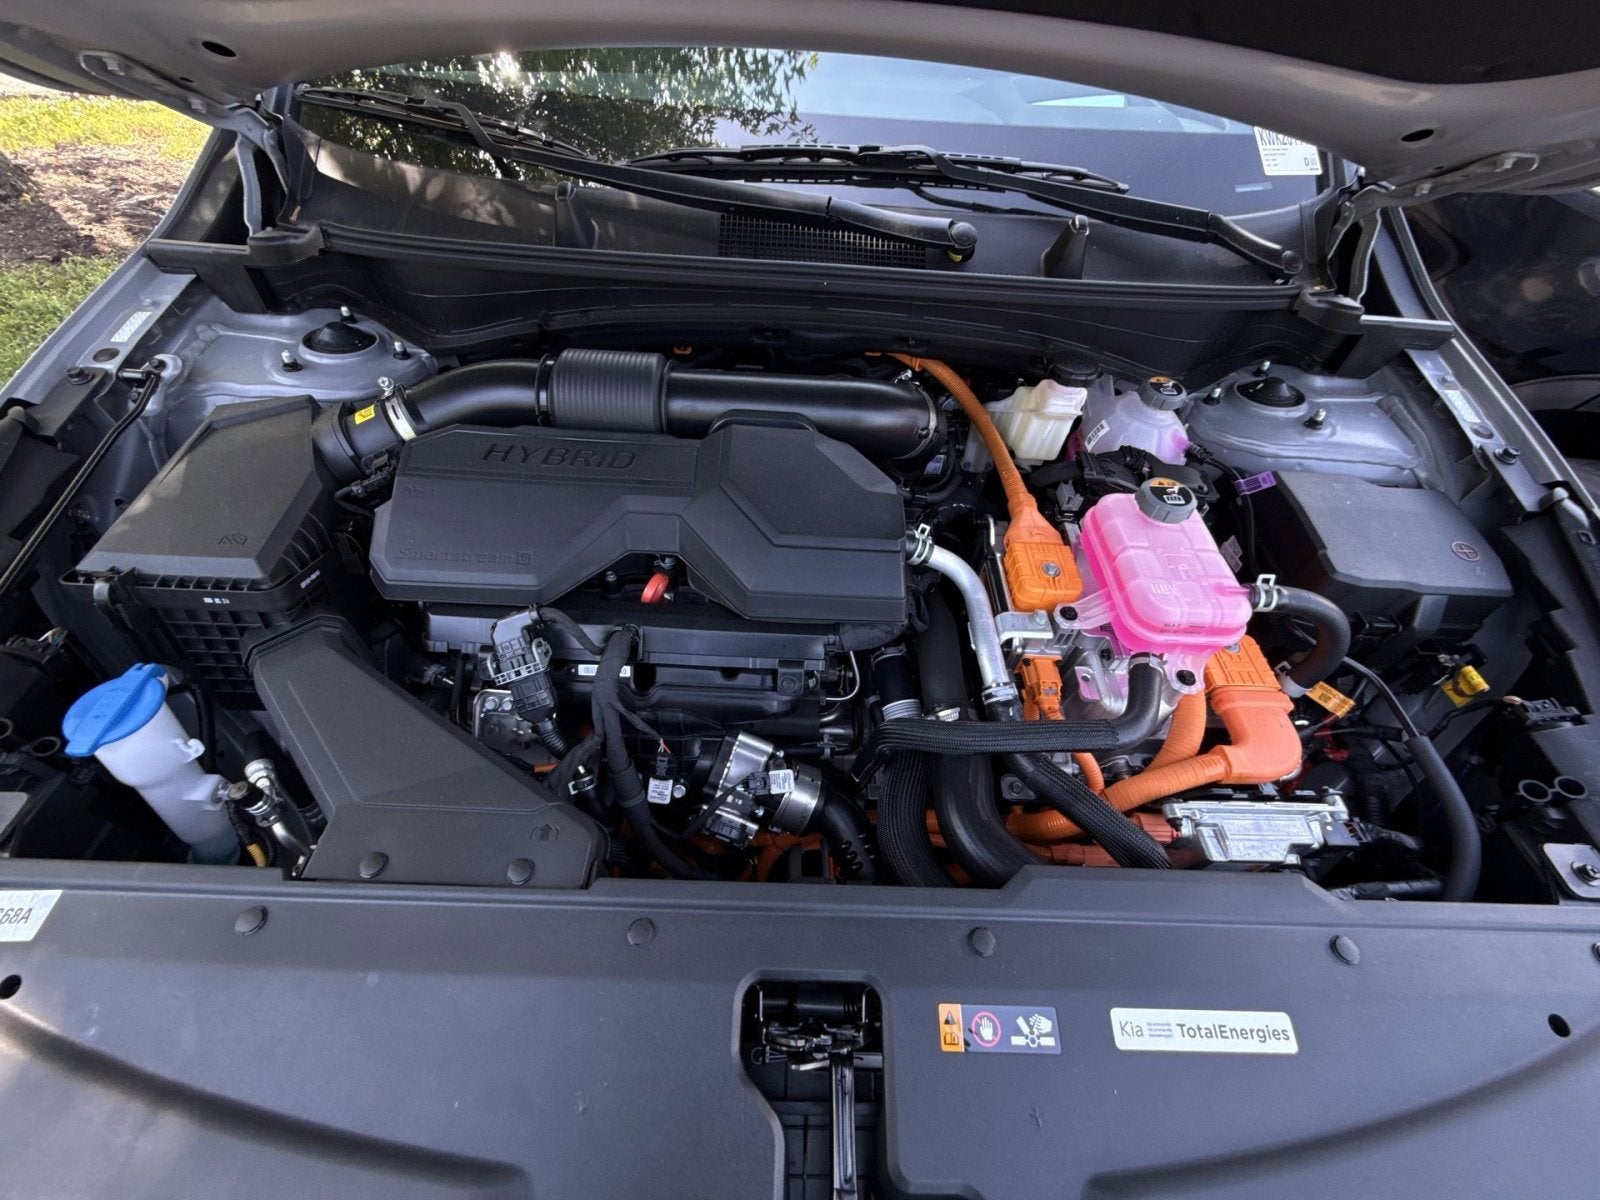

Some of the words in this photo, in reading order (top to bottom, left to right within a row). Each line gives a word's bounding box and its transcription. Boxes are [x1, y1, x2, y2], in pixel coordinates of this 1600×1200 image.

[482, 443, 637, 471] HYBRID
[397, 549, 514, 565] Smartstream
[1119, 1021, 1144, 1038] Kia
[1176, 1023, 1290, 1043] TotalEnergies
